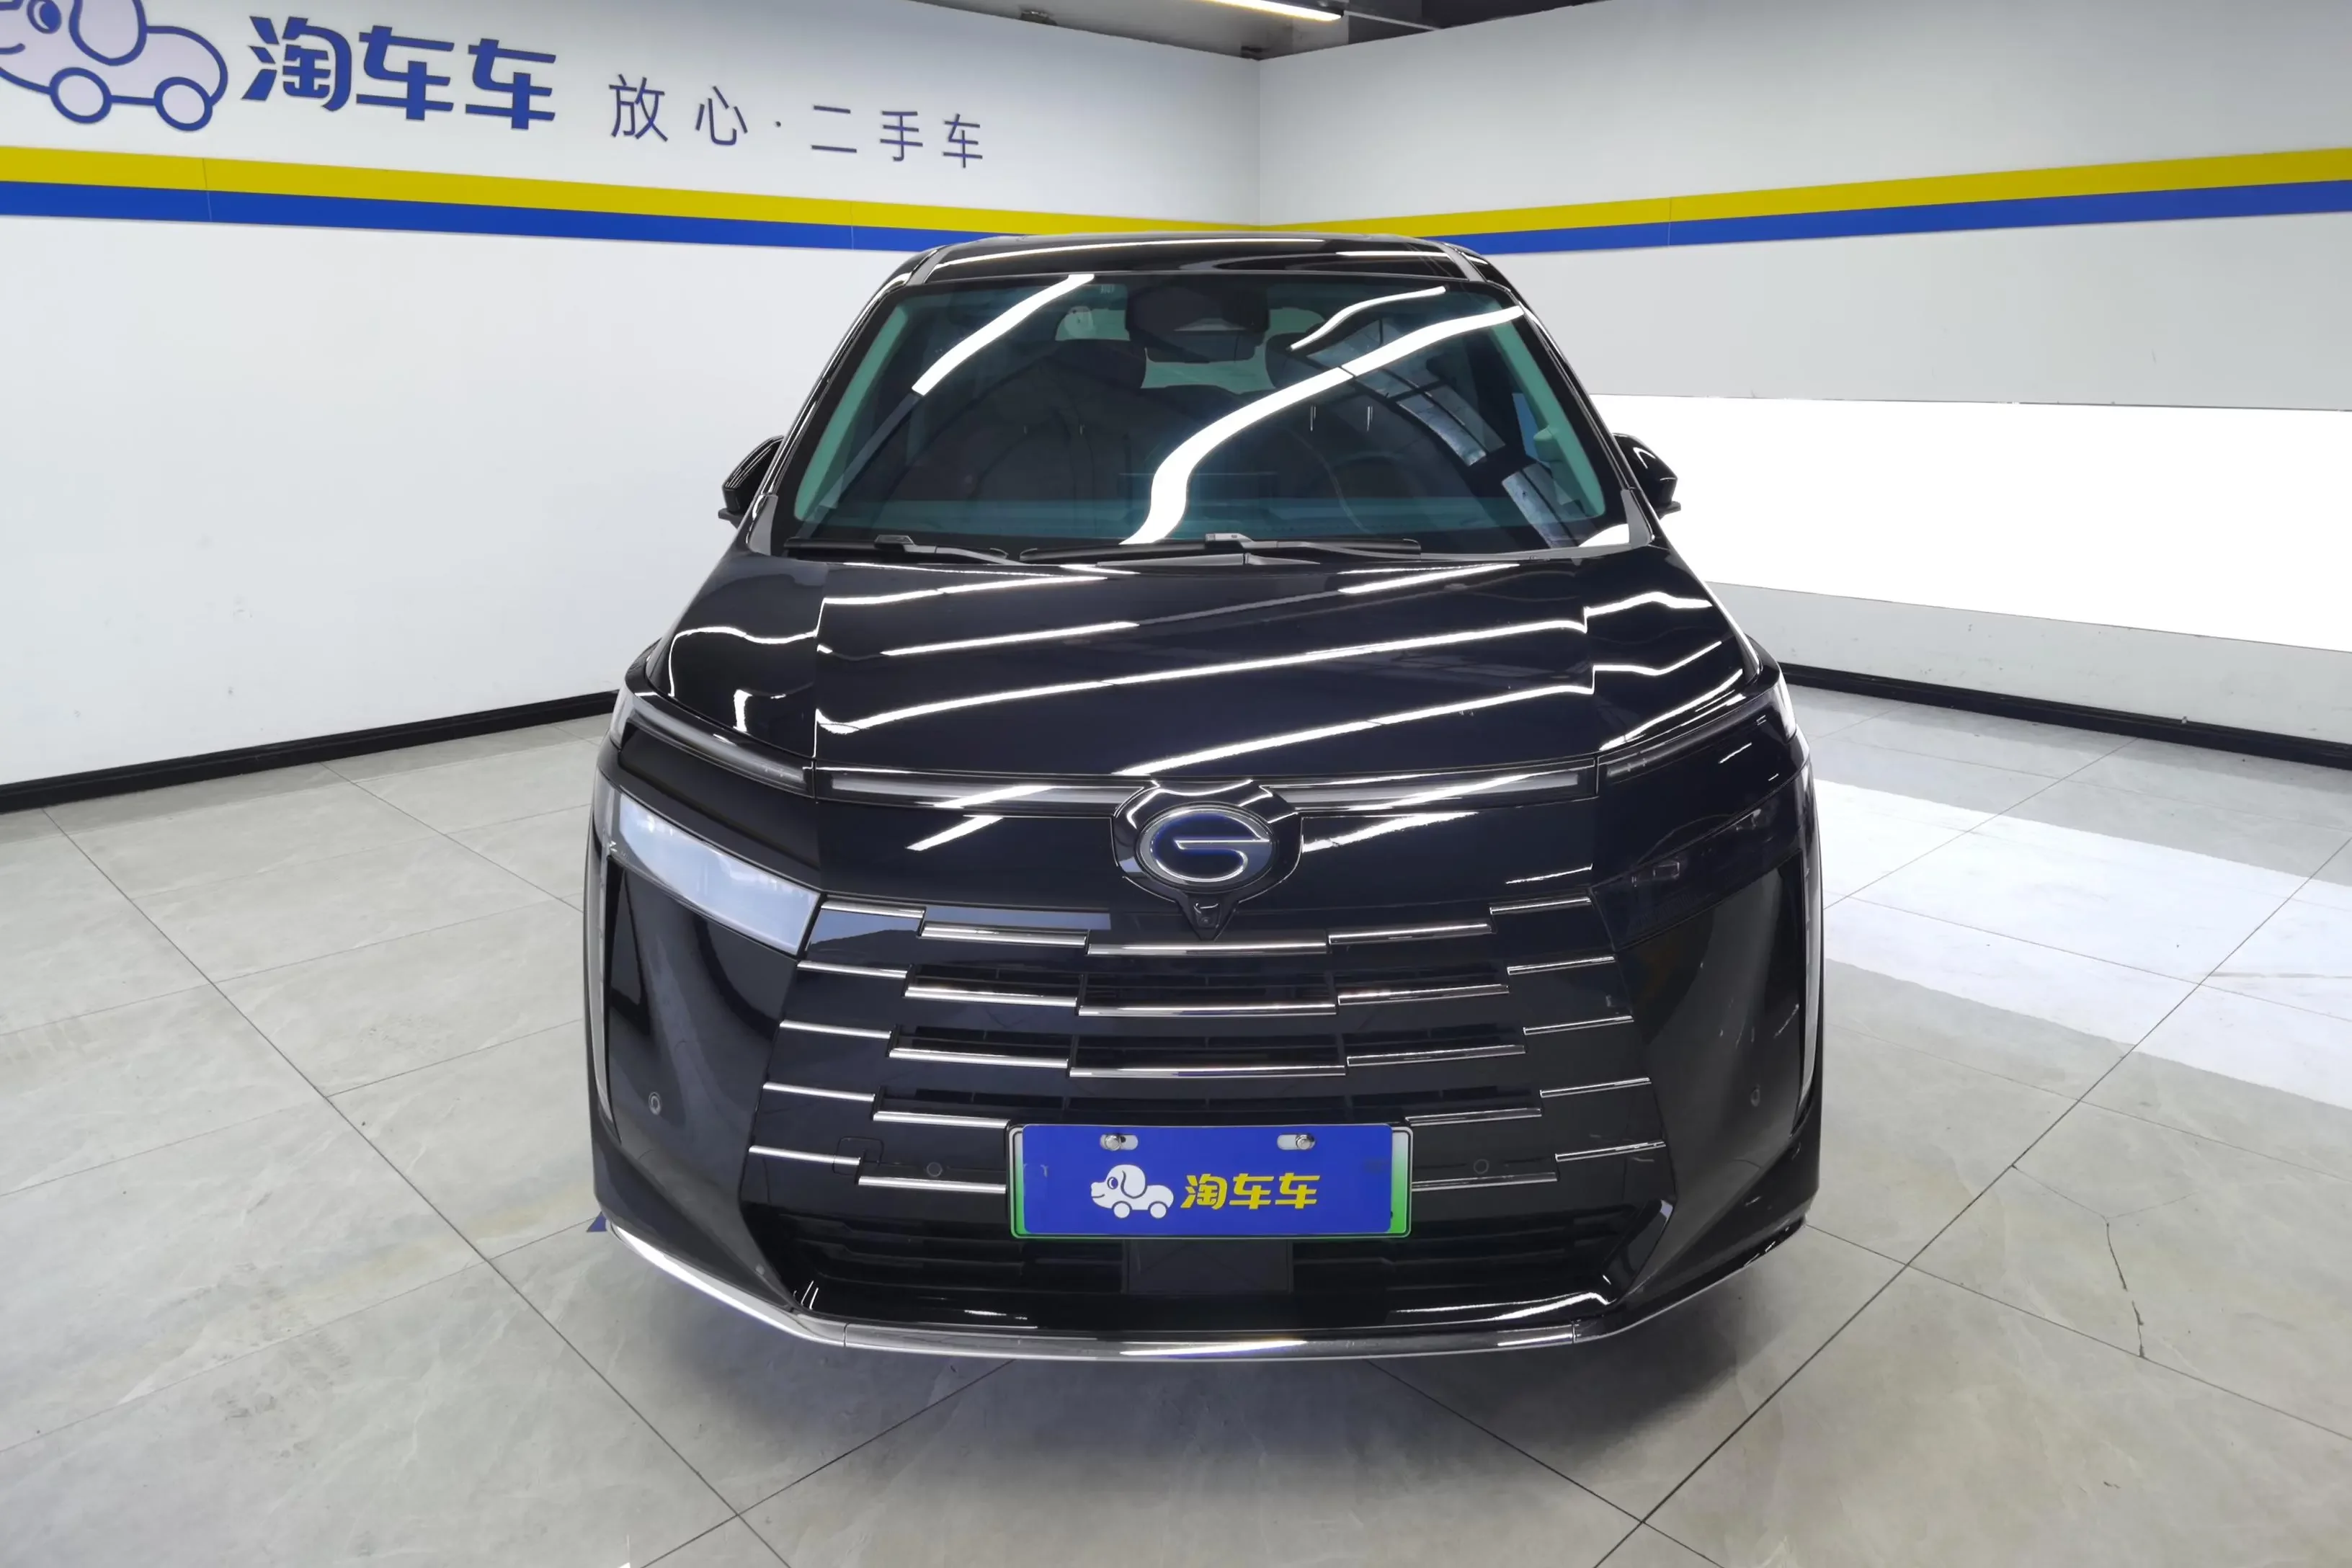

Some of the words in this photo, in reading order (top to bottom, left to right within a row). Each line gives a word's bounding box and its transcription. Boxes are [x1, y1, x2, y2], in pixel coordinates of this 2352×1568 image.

[241, 15, 556, 130] 淘车车
[1180, 1172, 1320, 1210] 淘车车
